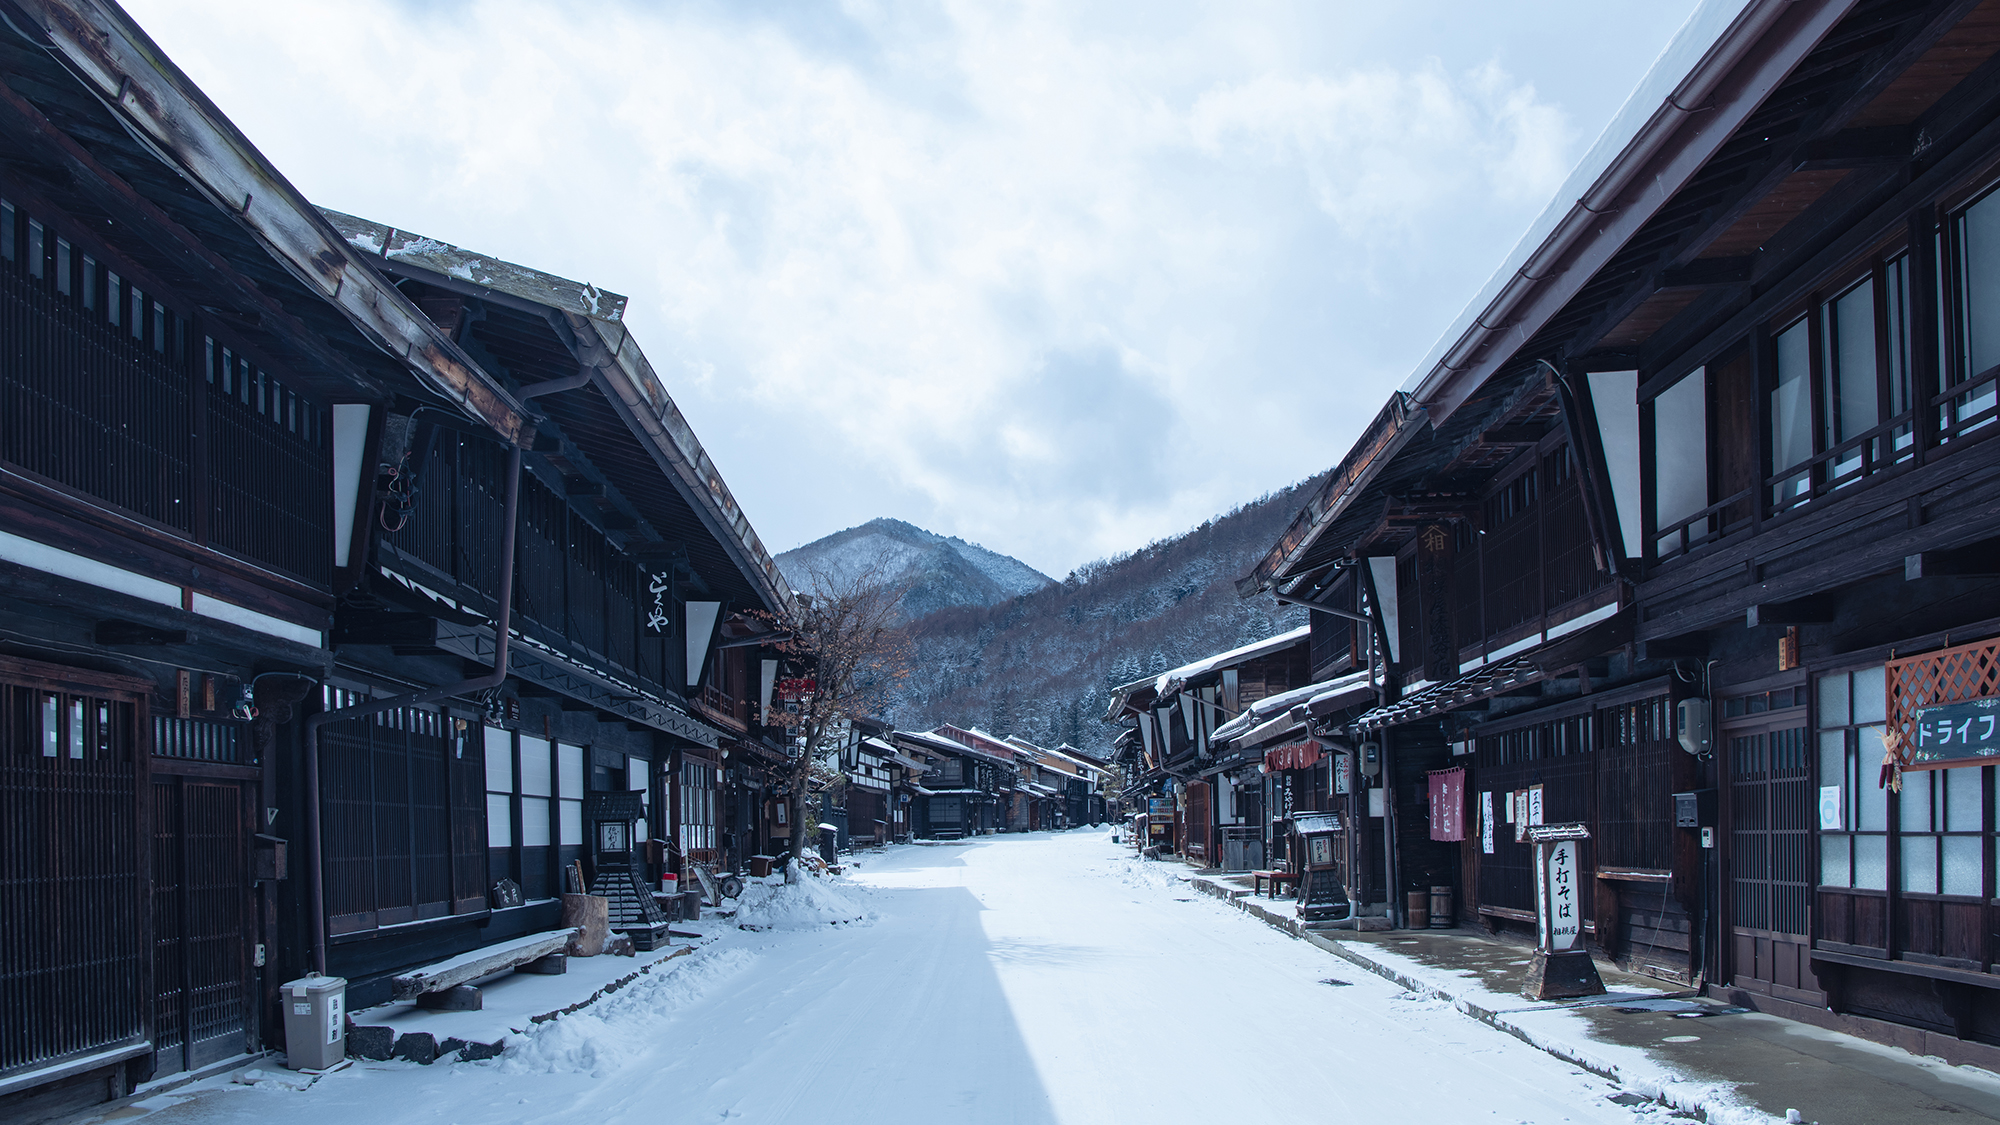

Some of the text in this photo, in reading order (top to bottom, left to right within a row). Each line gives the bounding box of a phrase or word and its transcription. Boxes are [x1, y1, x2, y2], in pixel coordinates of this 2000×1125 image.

[1918, 714, 1996, 747] ドライフ
[1336, 760, 1344, 792] たかしま
[1555, 848, 1572, 919] 手打そば
